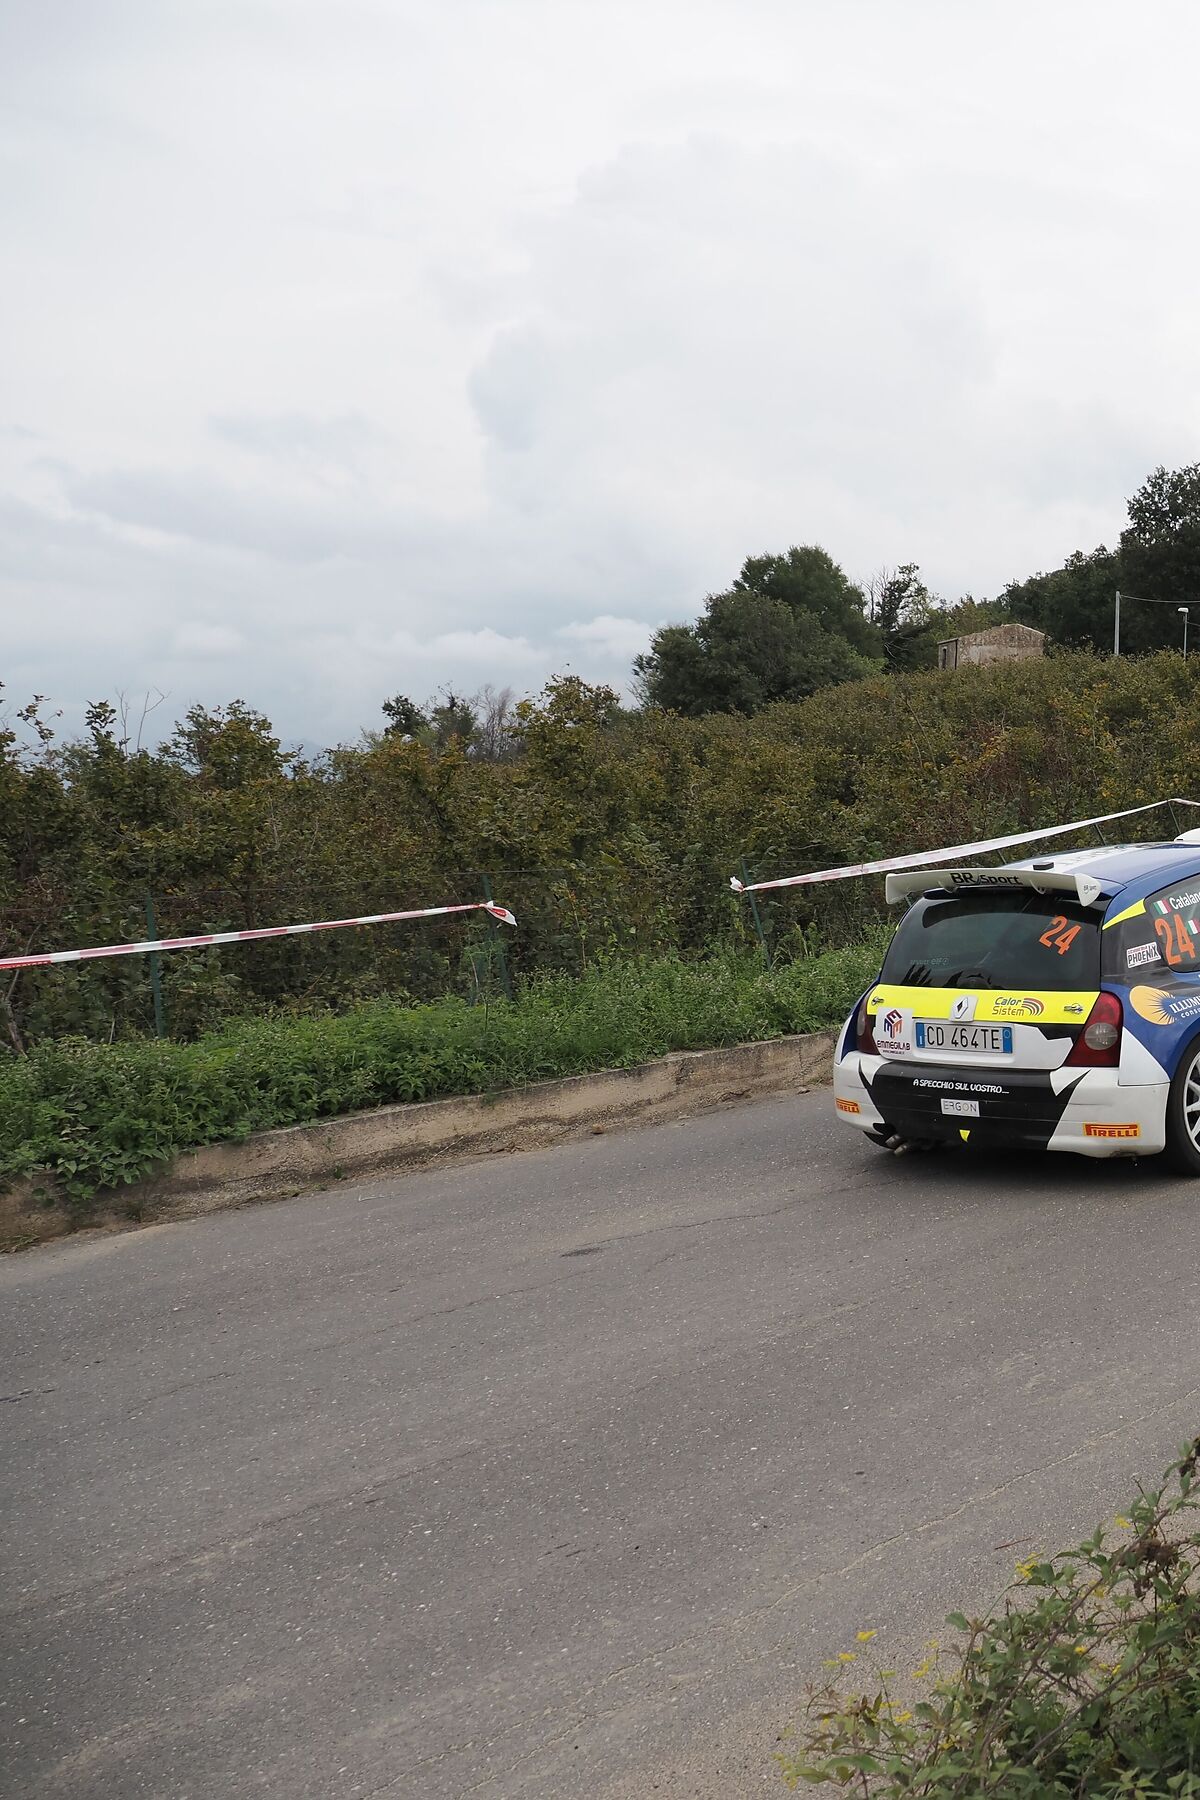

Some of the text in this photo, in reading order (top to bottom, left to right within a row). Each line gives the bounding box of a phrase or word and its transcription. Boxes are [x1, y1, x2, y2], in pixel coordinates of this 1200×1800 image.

[950, 872, 1023, 886] BR Sport
[1039, 915, 1082, 956] 24
[1154, 913, 1197, 965] 24
[995, 997, 1022, 1006] Calor
[992, 1005, 1025, 1016] Sistem
[926, 1026, 945, 1046] CD
[913, 1078, 919, 1086] A
[919, 1079, 954, 1090] SPECCHIO
[954, 1082, 970, 1091] SUL
[943, 1101, 977, 1112] ERGON
[1085, 1124, 1138, 1137] PIRELLI
